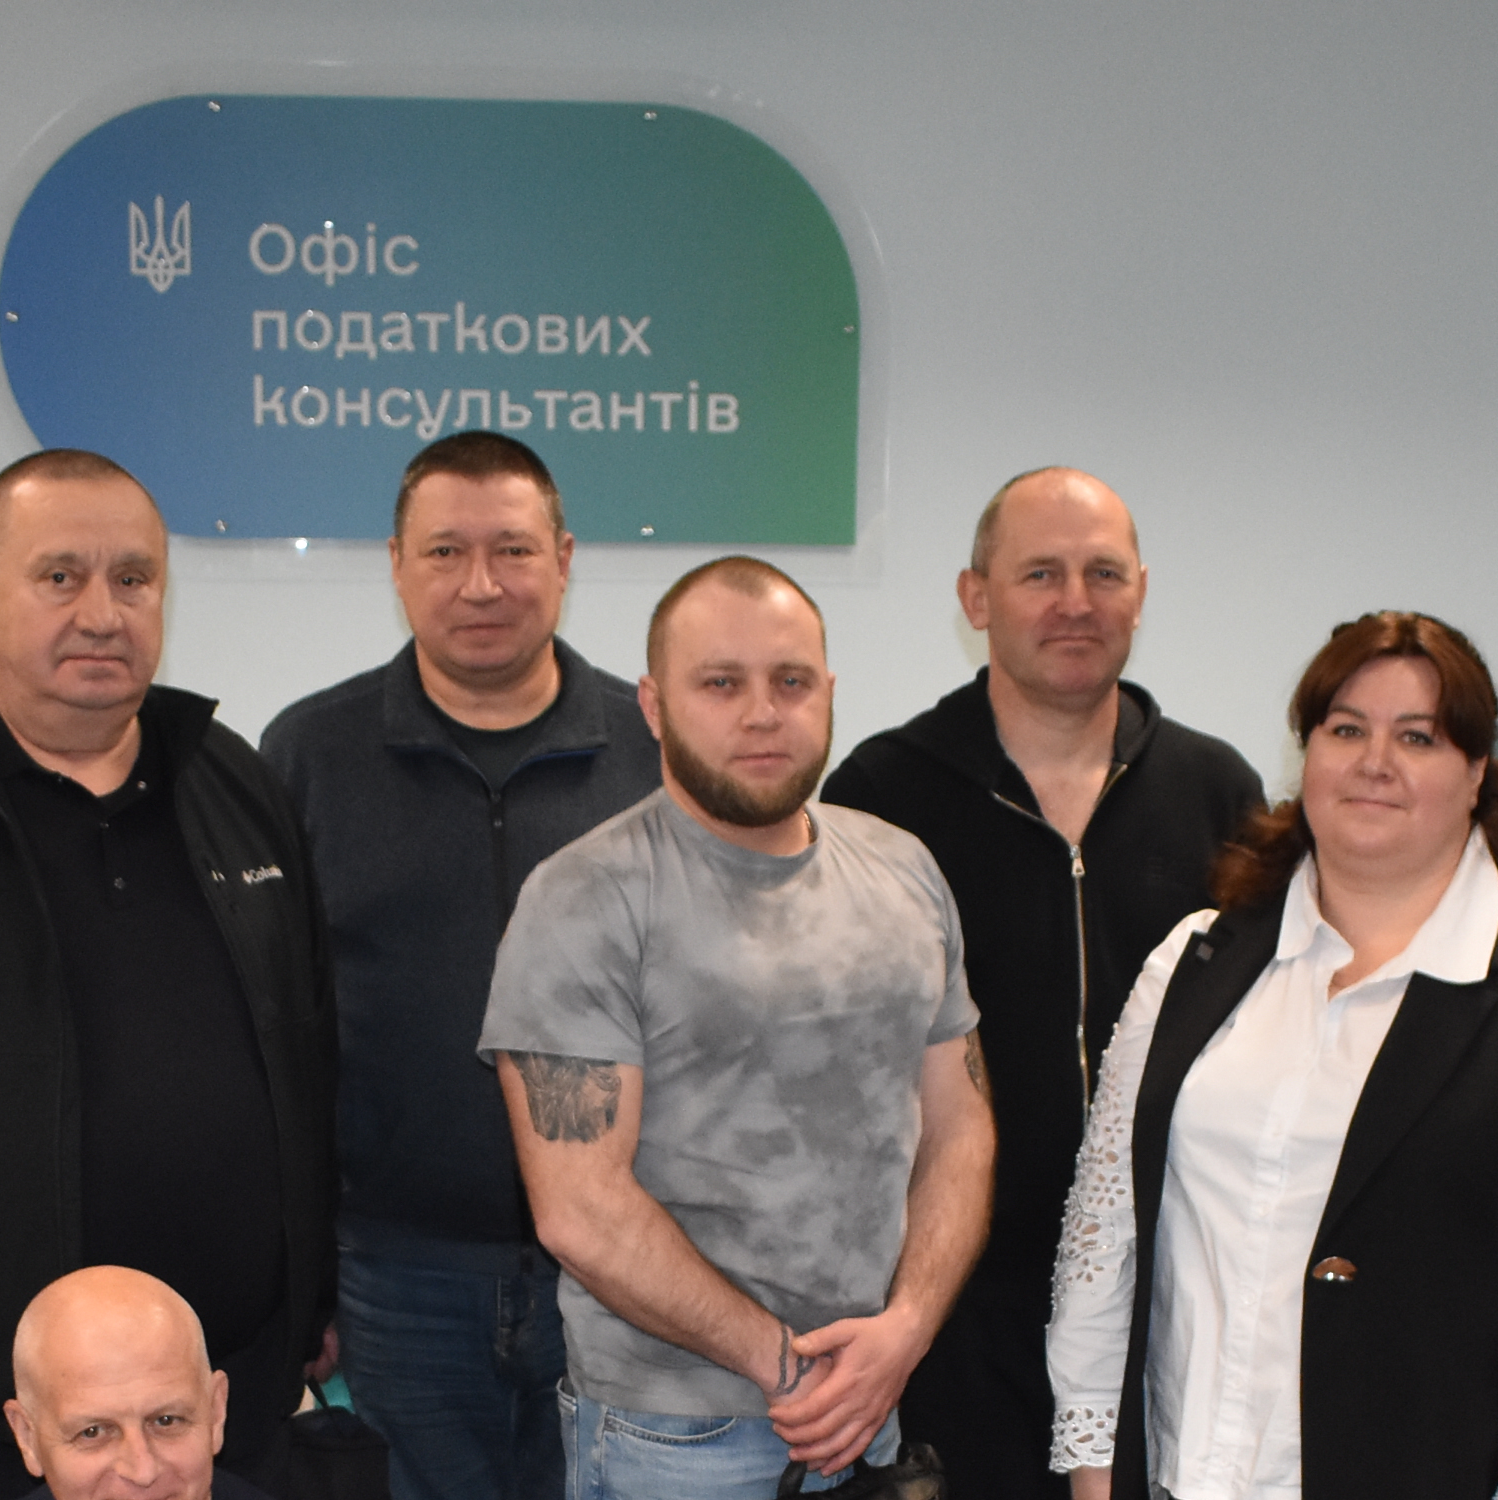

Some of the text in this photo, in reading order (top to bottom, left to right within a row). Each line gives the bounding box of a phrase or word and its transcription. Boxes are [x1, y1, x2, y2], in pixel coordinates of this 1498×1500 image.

[248, 221, 420, 286] Офіс
[251, 301, 652, 361] податкових
[251, 375, 741, 441] консультантів
